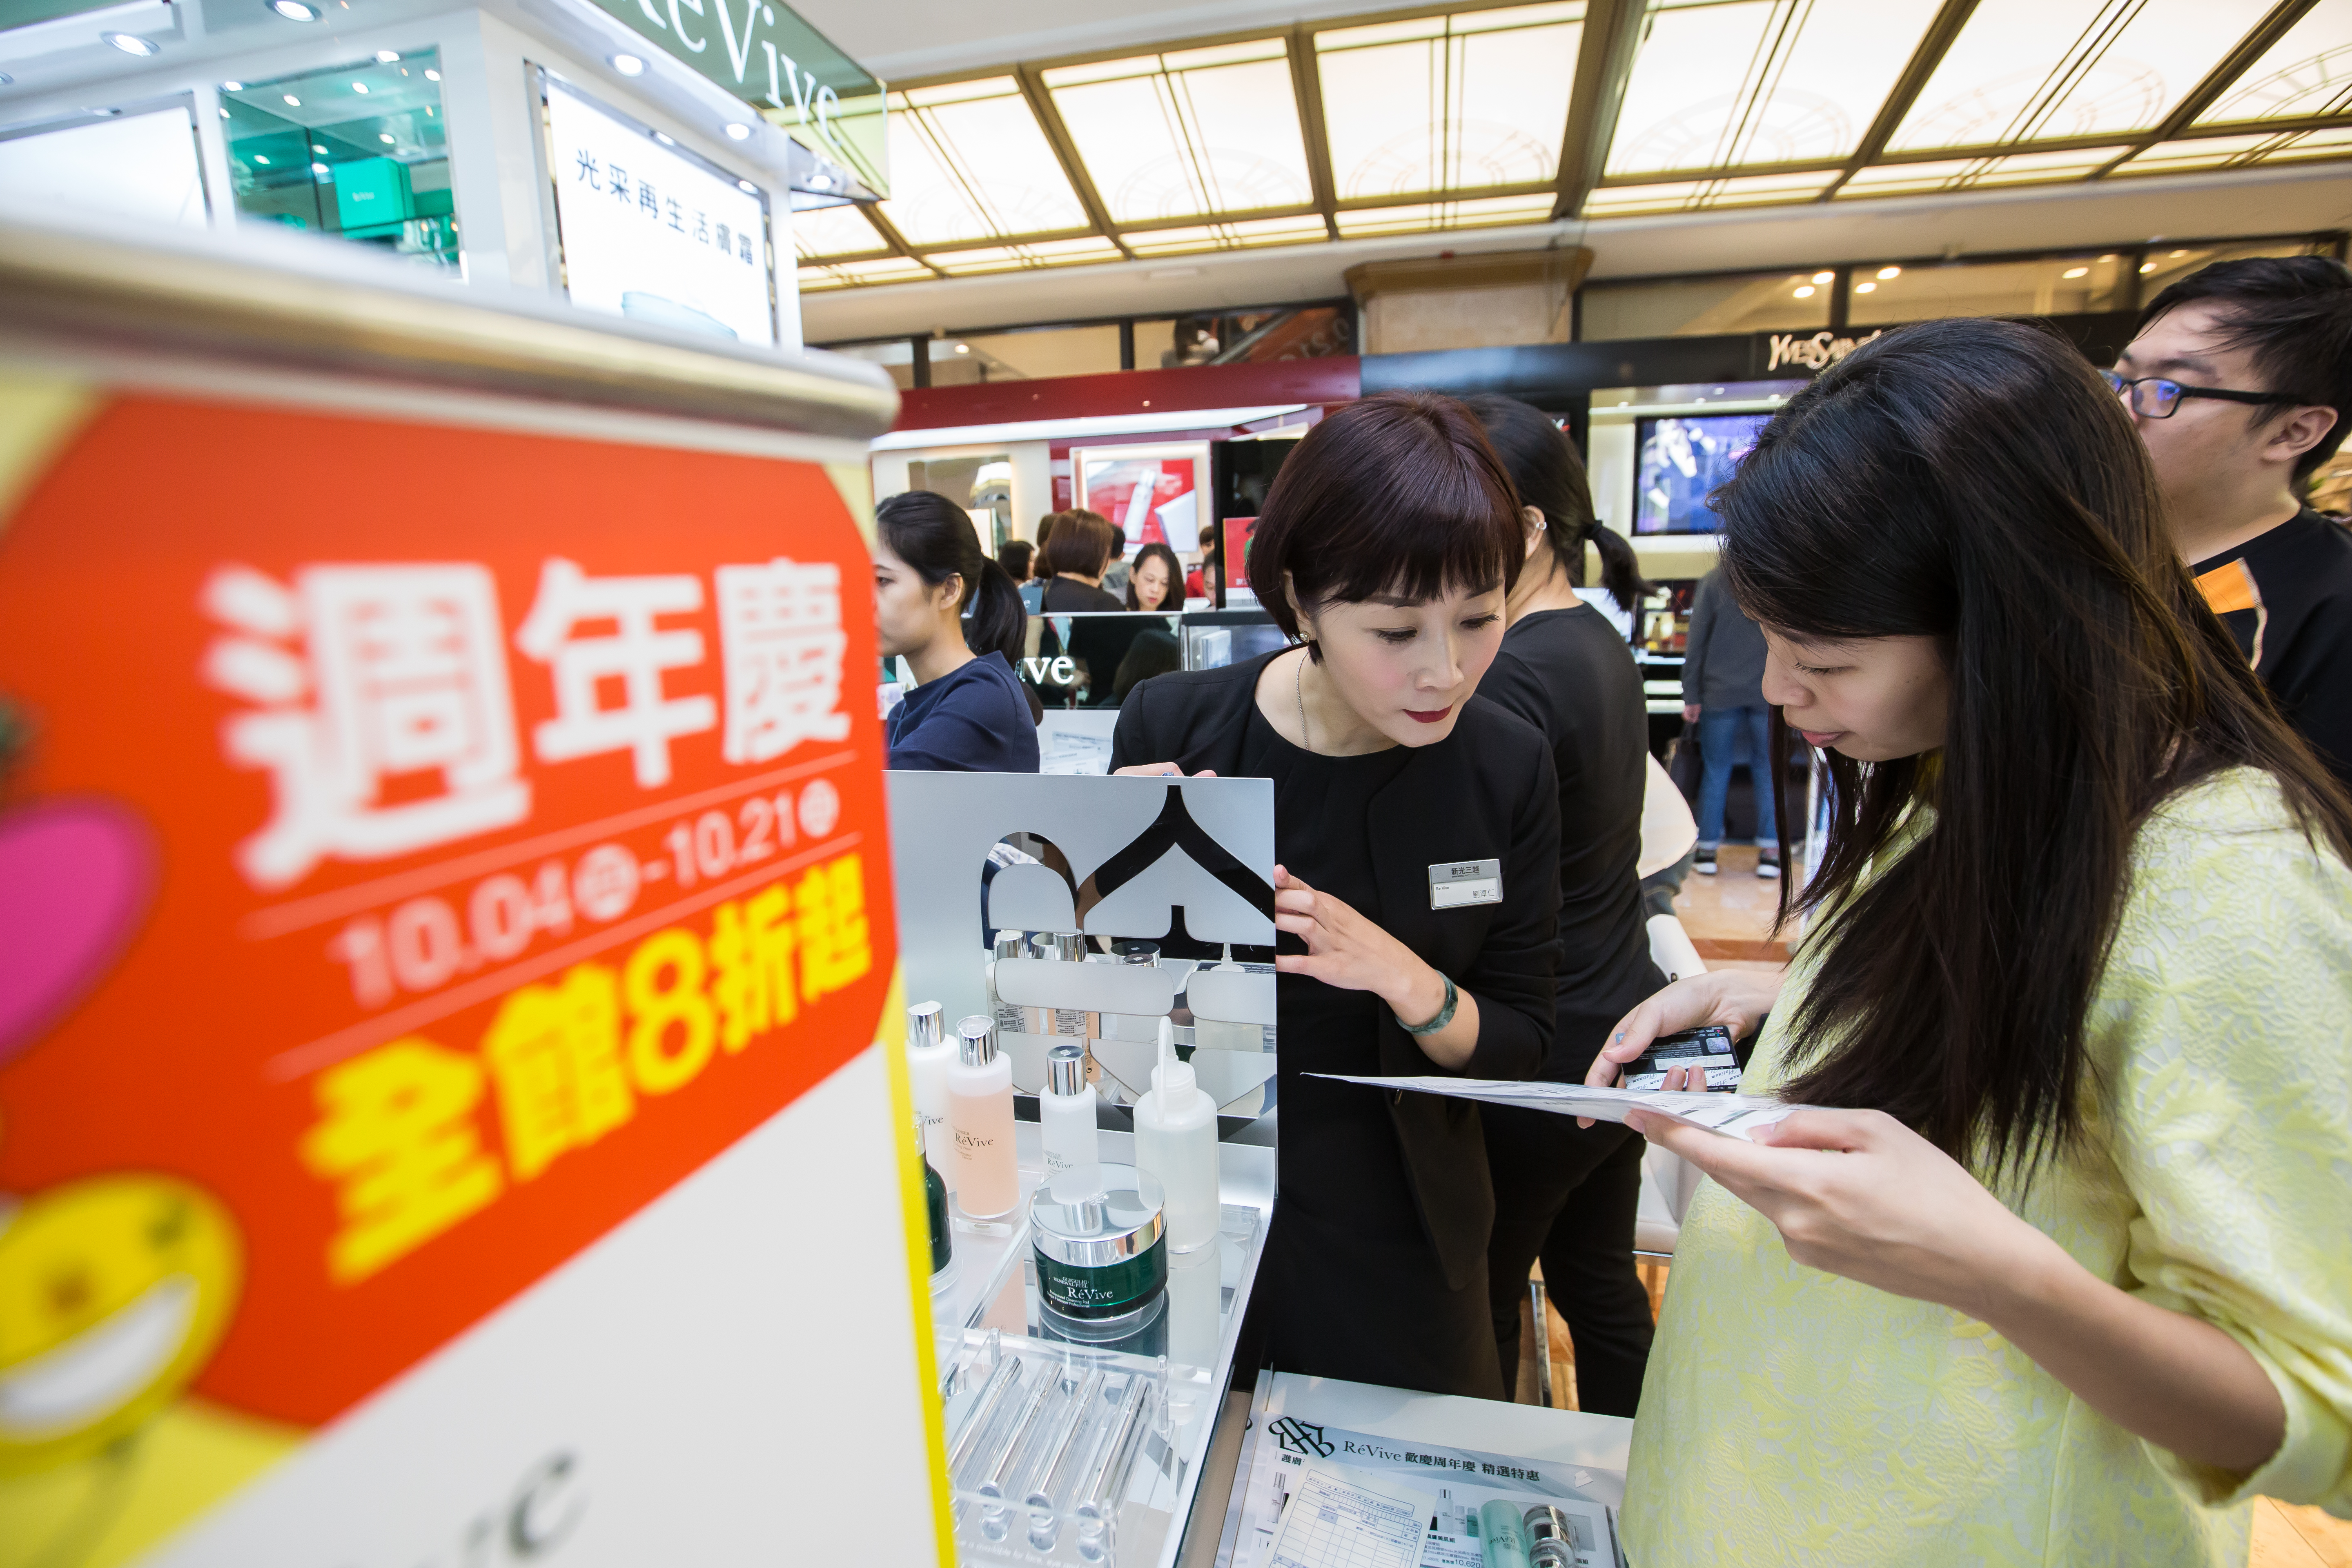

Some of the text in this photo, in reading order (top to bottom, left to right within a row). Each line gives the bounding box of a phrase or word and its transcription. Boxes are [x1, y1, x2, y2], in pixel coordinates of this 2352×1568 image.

[202, 556, 852, 893] 週年慶
[1451, 865, 1479, 875] 新光三越
[300, 853, 873, 1286] 全館8折起
[956, 1132, 993, 1147] RéVive
[1067, 1287, 1114, 1300] RéVive
[1281, 1453, 1305, 1466] 護膚
[1343, 1440, 1540, 1481] RéVive 歡慶周年慶 精選特惠
[1455, 1559, 1481, 1568] 10,620
